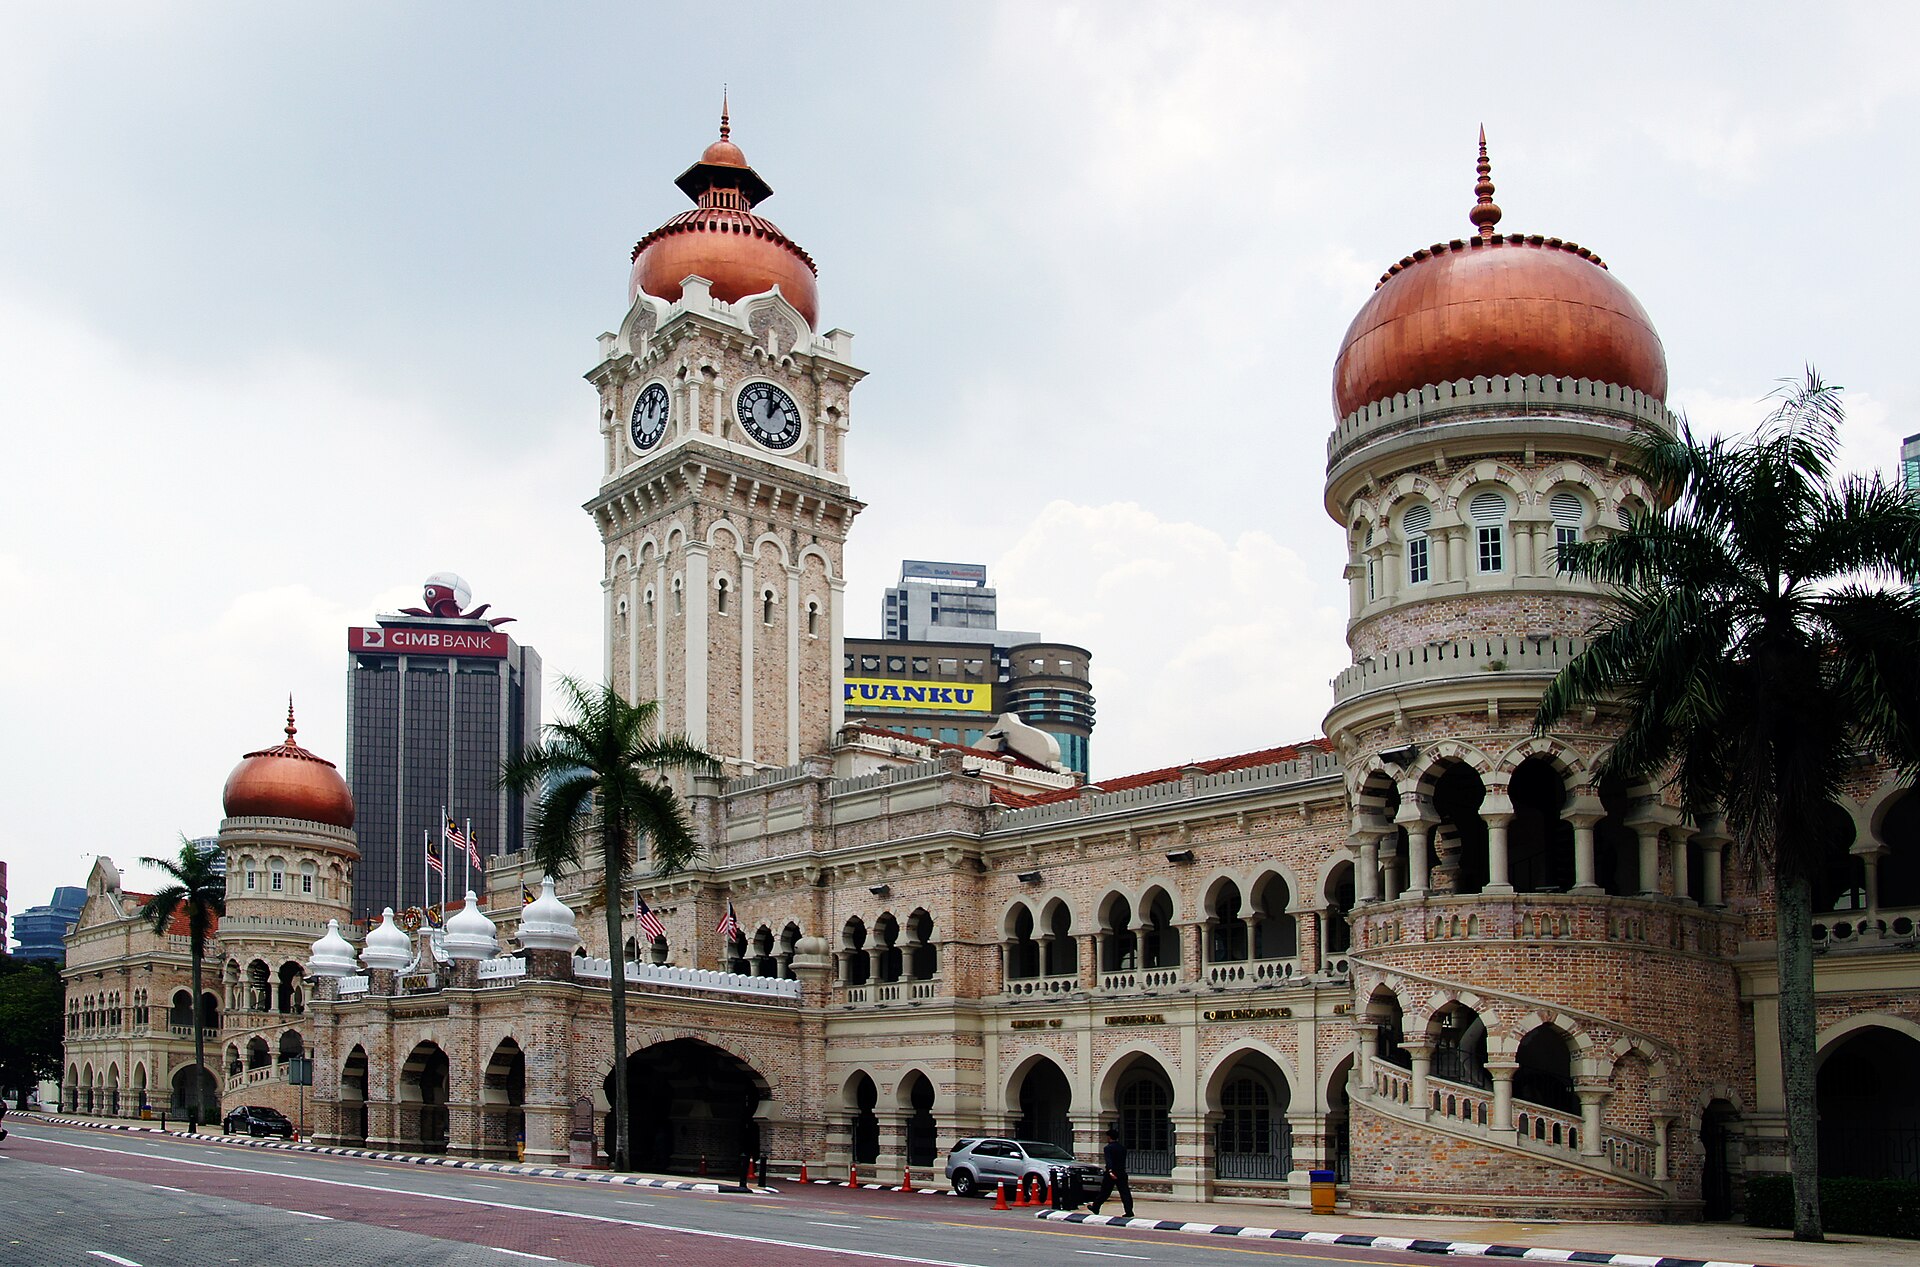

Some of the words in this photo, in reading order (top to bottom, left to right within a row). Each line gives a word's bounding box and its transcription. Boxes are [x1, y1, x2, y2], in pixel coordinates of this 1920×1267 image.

[392, 632, 439, 646] CIMB
[443, 634, 491, 649] BANK
[844, 683, 974, 704] TUANKU
